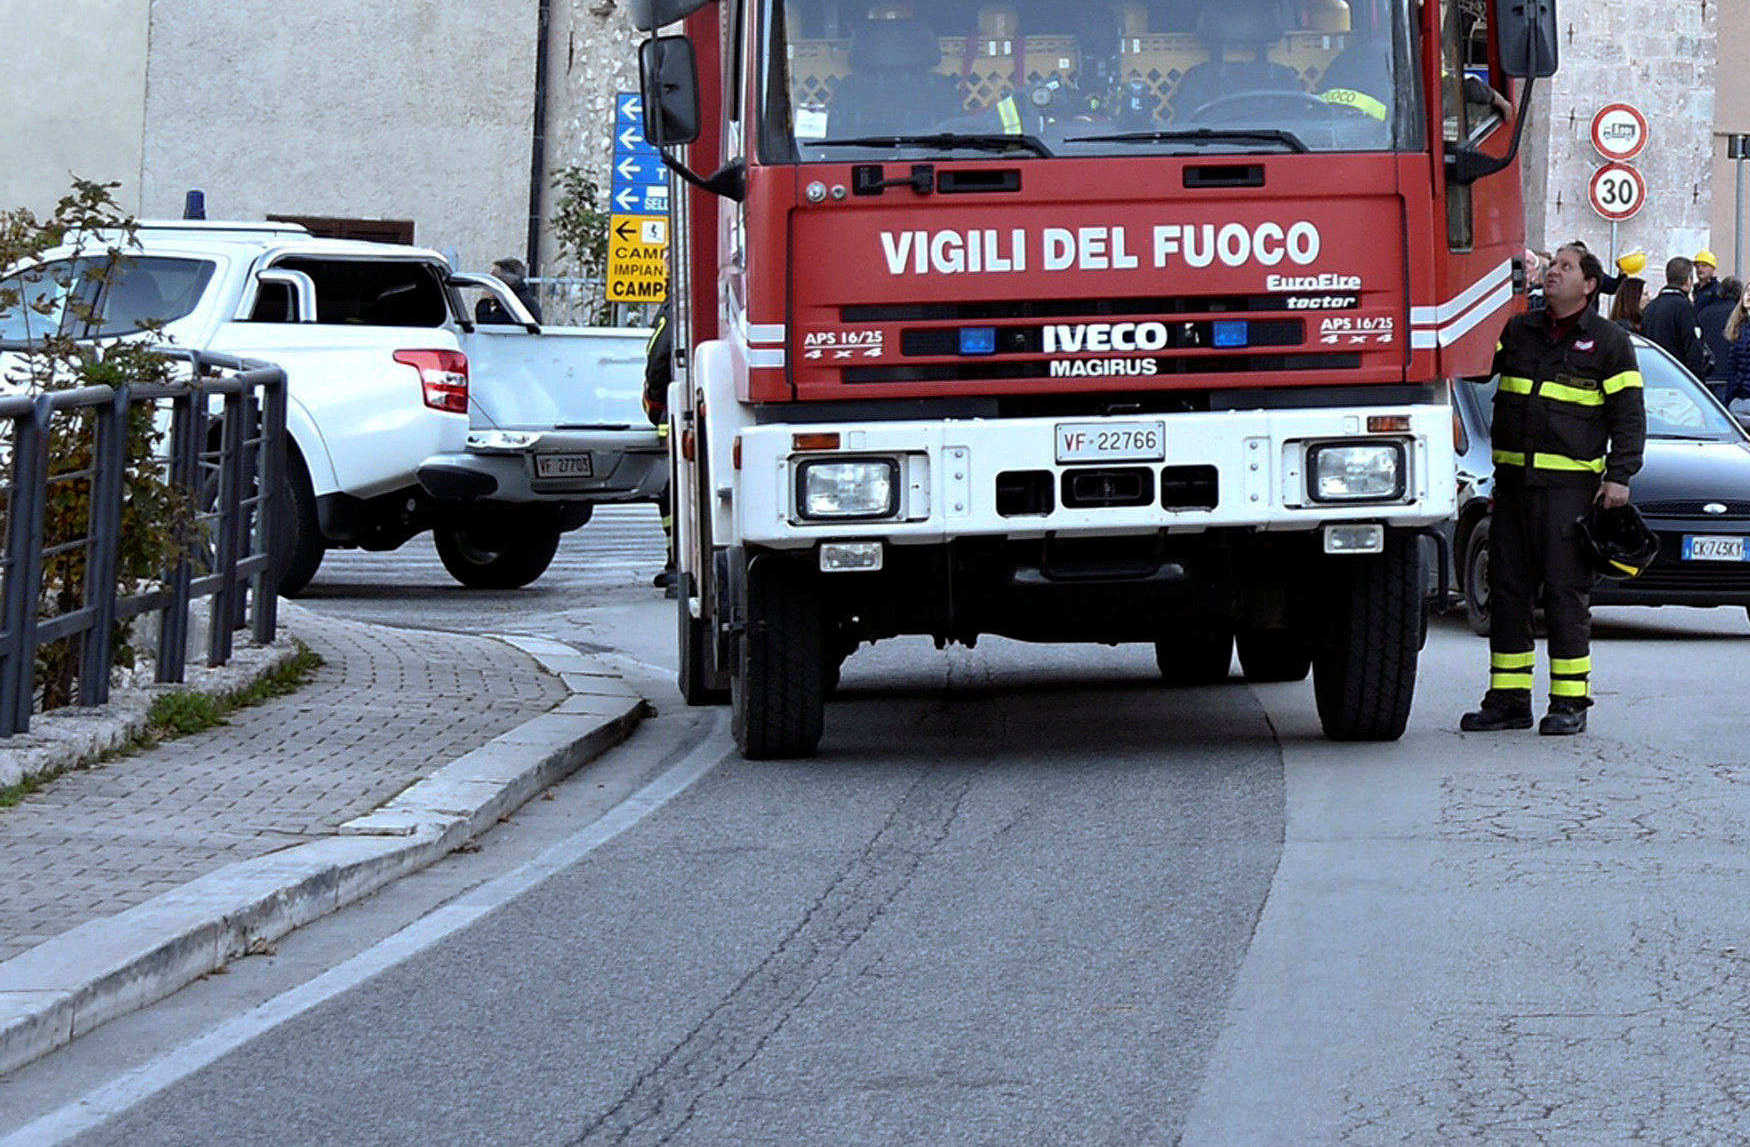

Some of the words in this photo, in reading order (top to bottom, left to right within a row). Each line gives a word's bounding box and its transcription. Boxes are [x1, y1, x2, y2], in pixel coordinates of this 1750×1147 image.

[1601, 178, 1633, 205] 30
[881, 228, 1026, 275] VIGILI
[1043, 226, 1139, 271] DEL
[1153, 221, 1321, 269] FUOCO
[613, 264, 664, 277] IMPIAN
[1320, 317, 1352, 331] APS
[1356, 316, 1394, 330] 16/25
[804, 331, 837, 345] APS
[841, 330, 884, 344] 16/25
[1042, 321, 1169, 354] IVECO
[1049, 357, 1158, 377] MAGIRUS
[1064, 432, 1087, 452] VF
[1097, 430, 1157, 451] 22766
